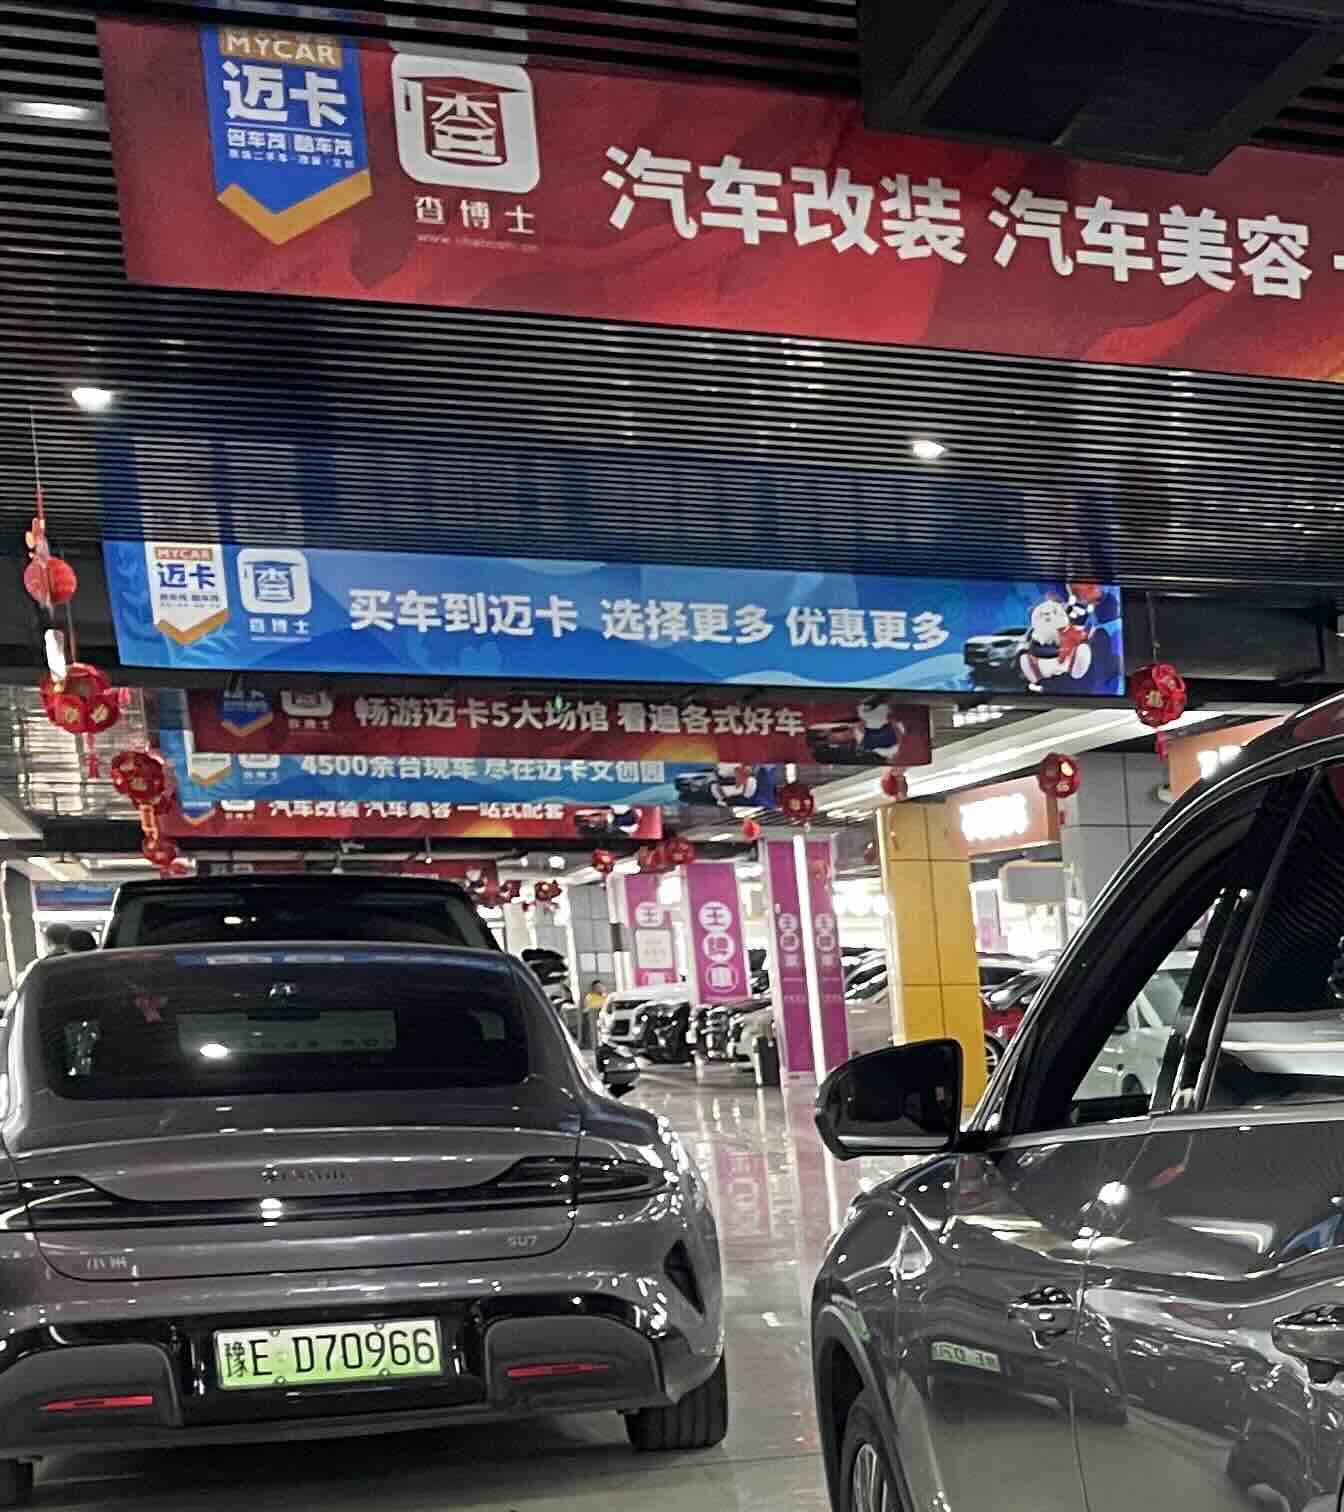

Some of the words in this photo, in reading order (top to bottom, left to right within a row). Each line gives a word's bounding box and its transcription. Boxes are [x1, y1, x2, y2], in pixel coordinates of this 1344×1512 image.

[225, 32, 337, 66] MYCAR
[221, 60, 348, 128] 迈卡
[601, 144, 970, 267] 汽车改装
[989, 185, 1314, 301] 汽车美容
[156, 562, 217, 589] 迈卡
[349, 587, 579, 639] 买车到迈卡
[600, 599, 775, 644] 选择更多
[785, 605, 950, 653] 优惠更多
[353, 695, 610, 733] 畅游迈卡5大场馆
[617, 701, 806, 737] 看遍各式好车
[300, 754, 478, 780] 4500余台现车
